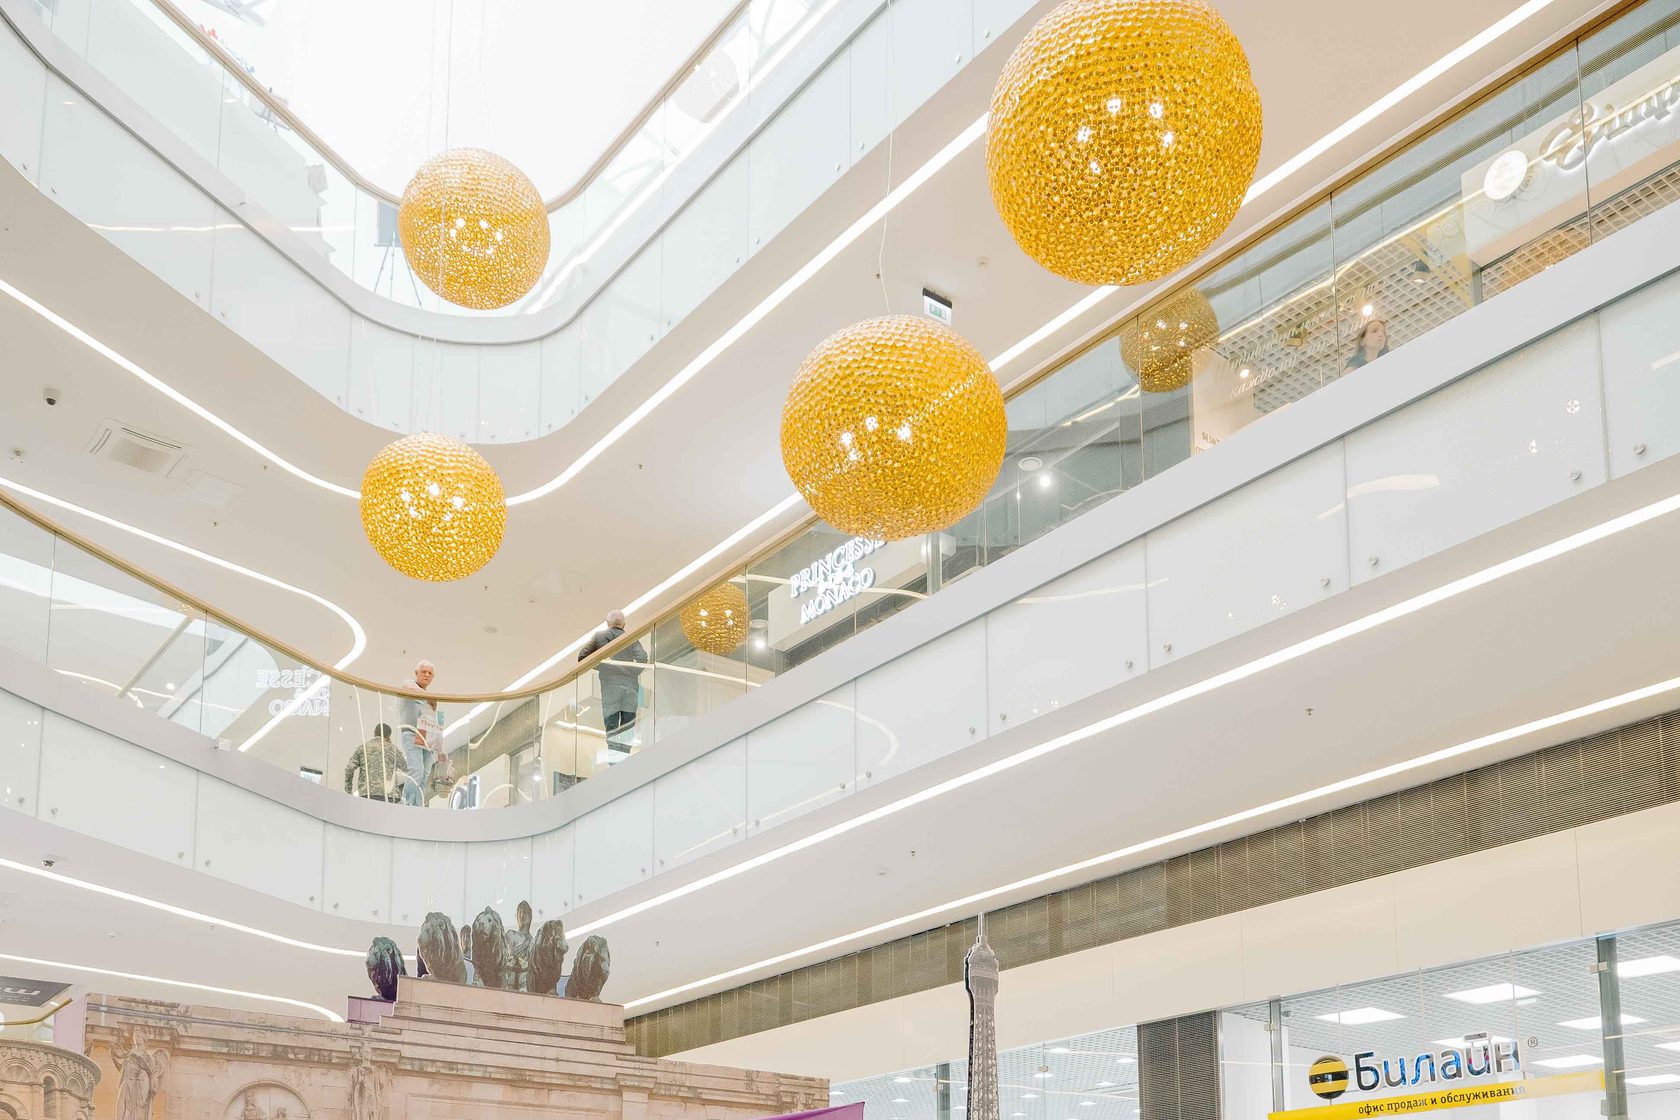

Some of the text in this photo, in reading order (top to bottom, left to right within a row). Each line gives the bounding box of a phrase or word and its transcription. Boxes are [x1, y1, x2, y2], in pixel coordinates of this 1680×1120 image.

[800, 567, 875, 624] MONACO
[1354, 1032, 1521, 1092] Билайн
[1358, 1085, 1526, 1115] офис продаж и обслуживания
